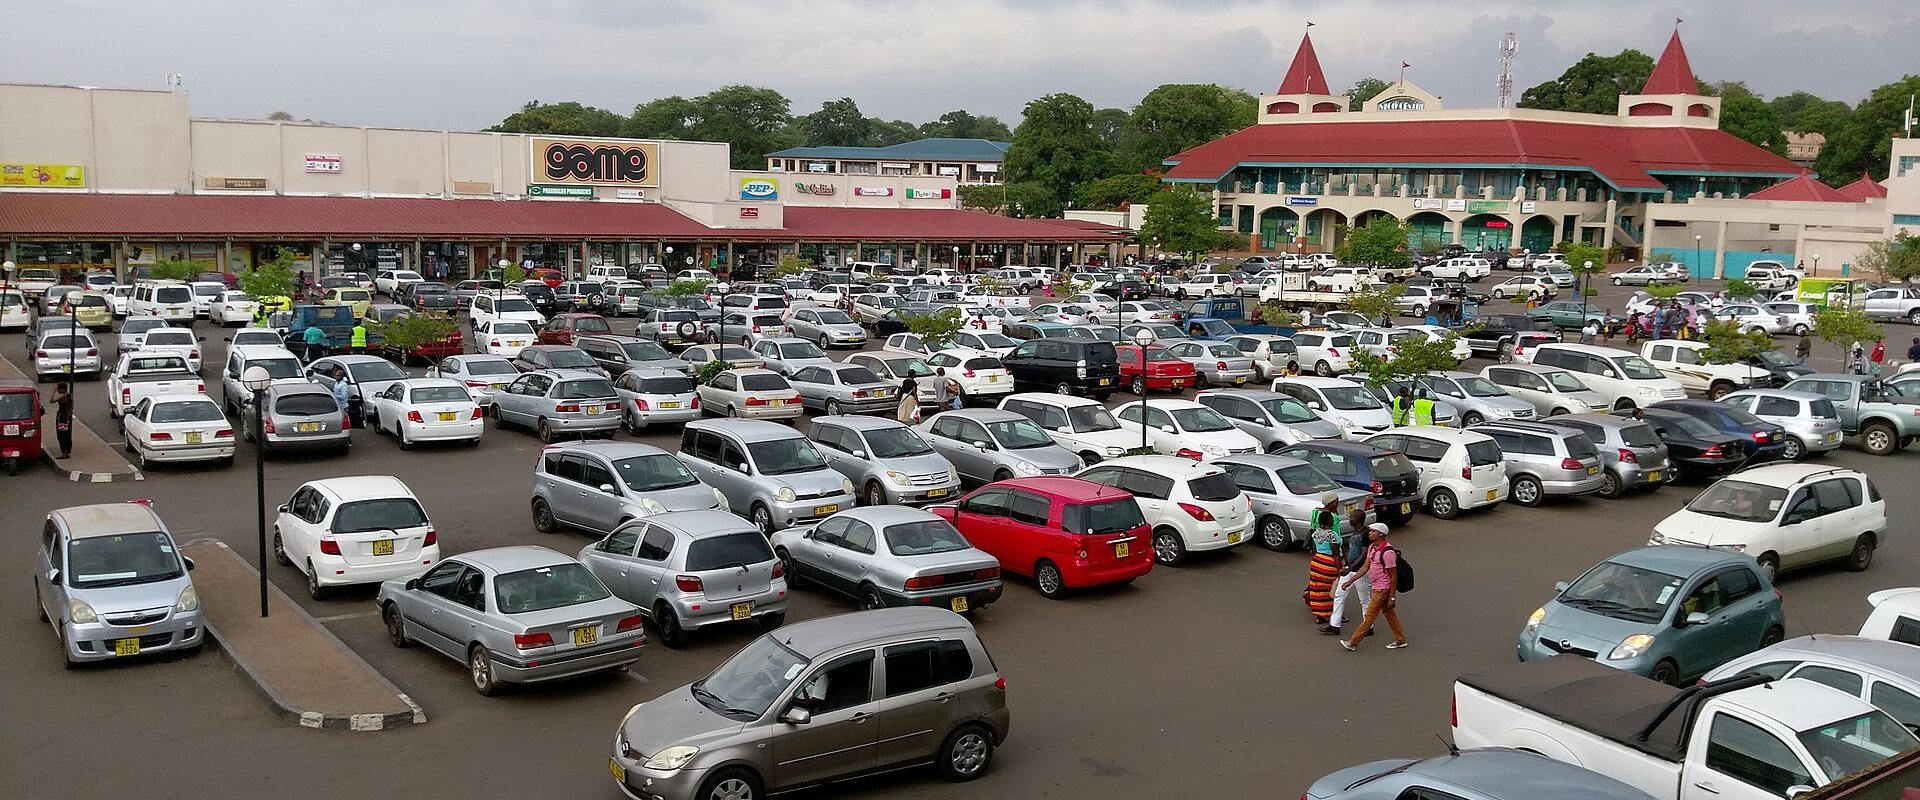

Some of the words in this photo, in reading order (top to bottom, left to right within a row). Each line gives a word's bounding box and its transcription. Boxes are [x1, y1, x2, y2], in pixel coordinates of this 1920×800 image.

[545, 143, 648, 183] game
[747, 184, 771, 193] PEP
[120, 646, 138, 655] 3926
